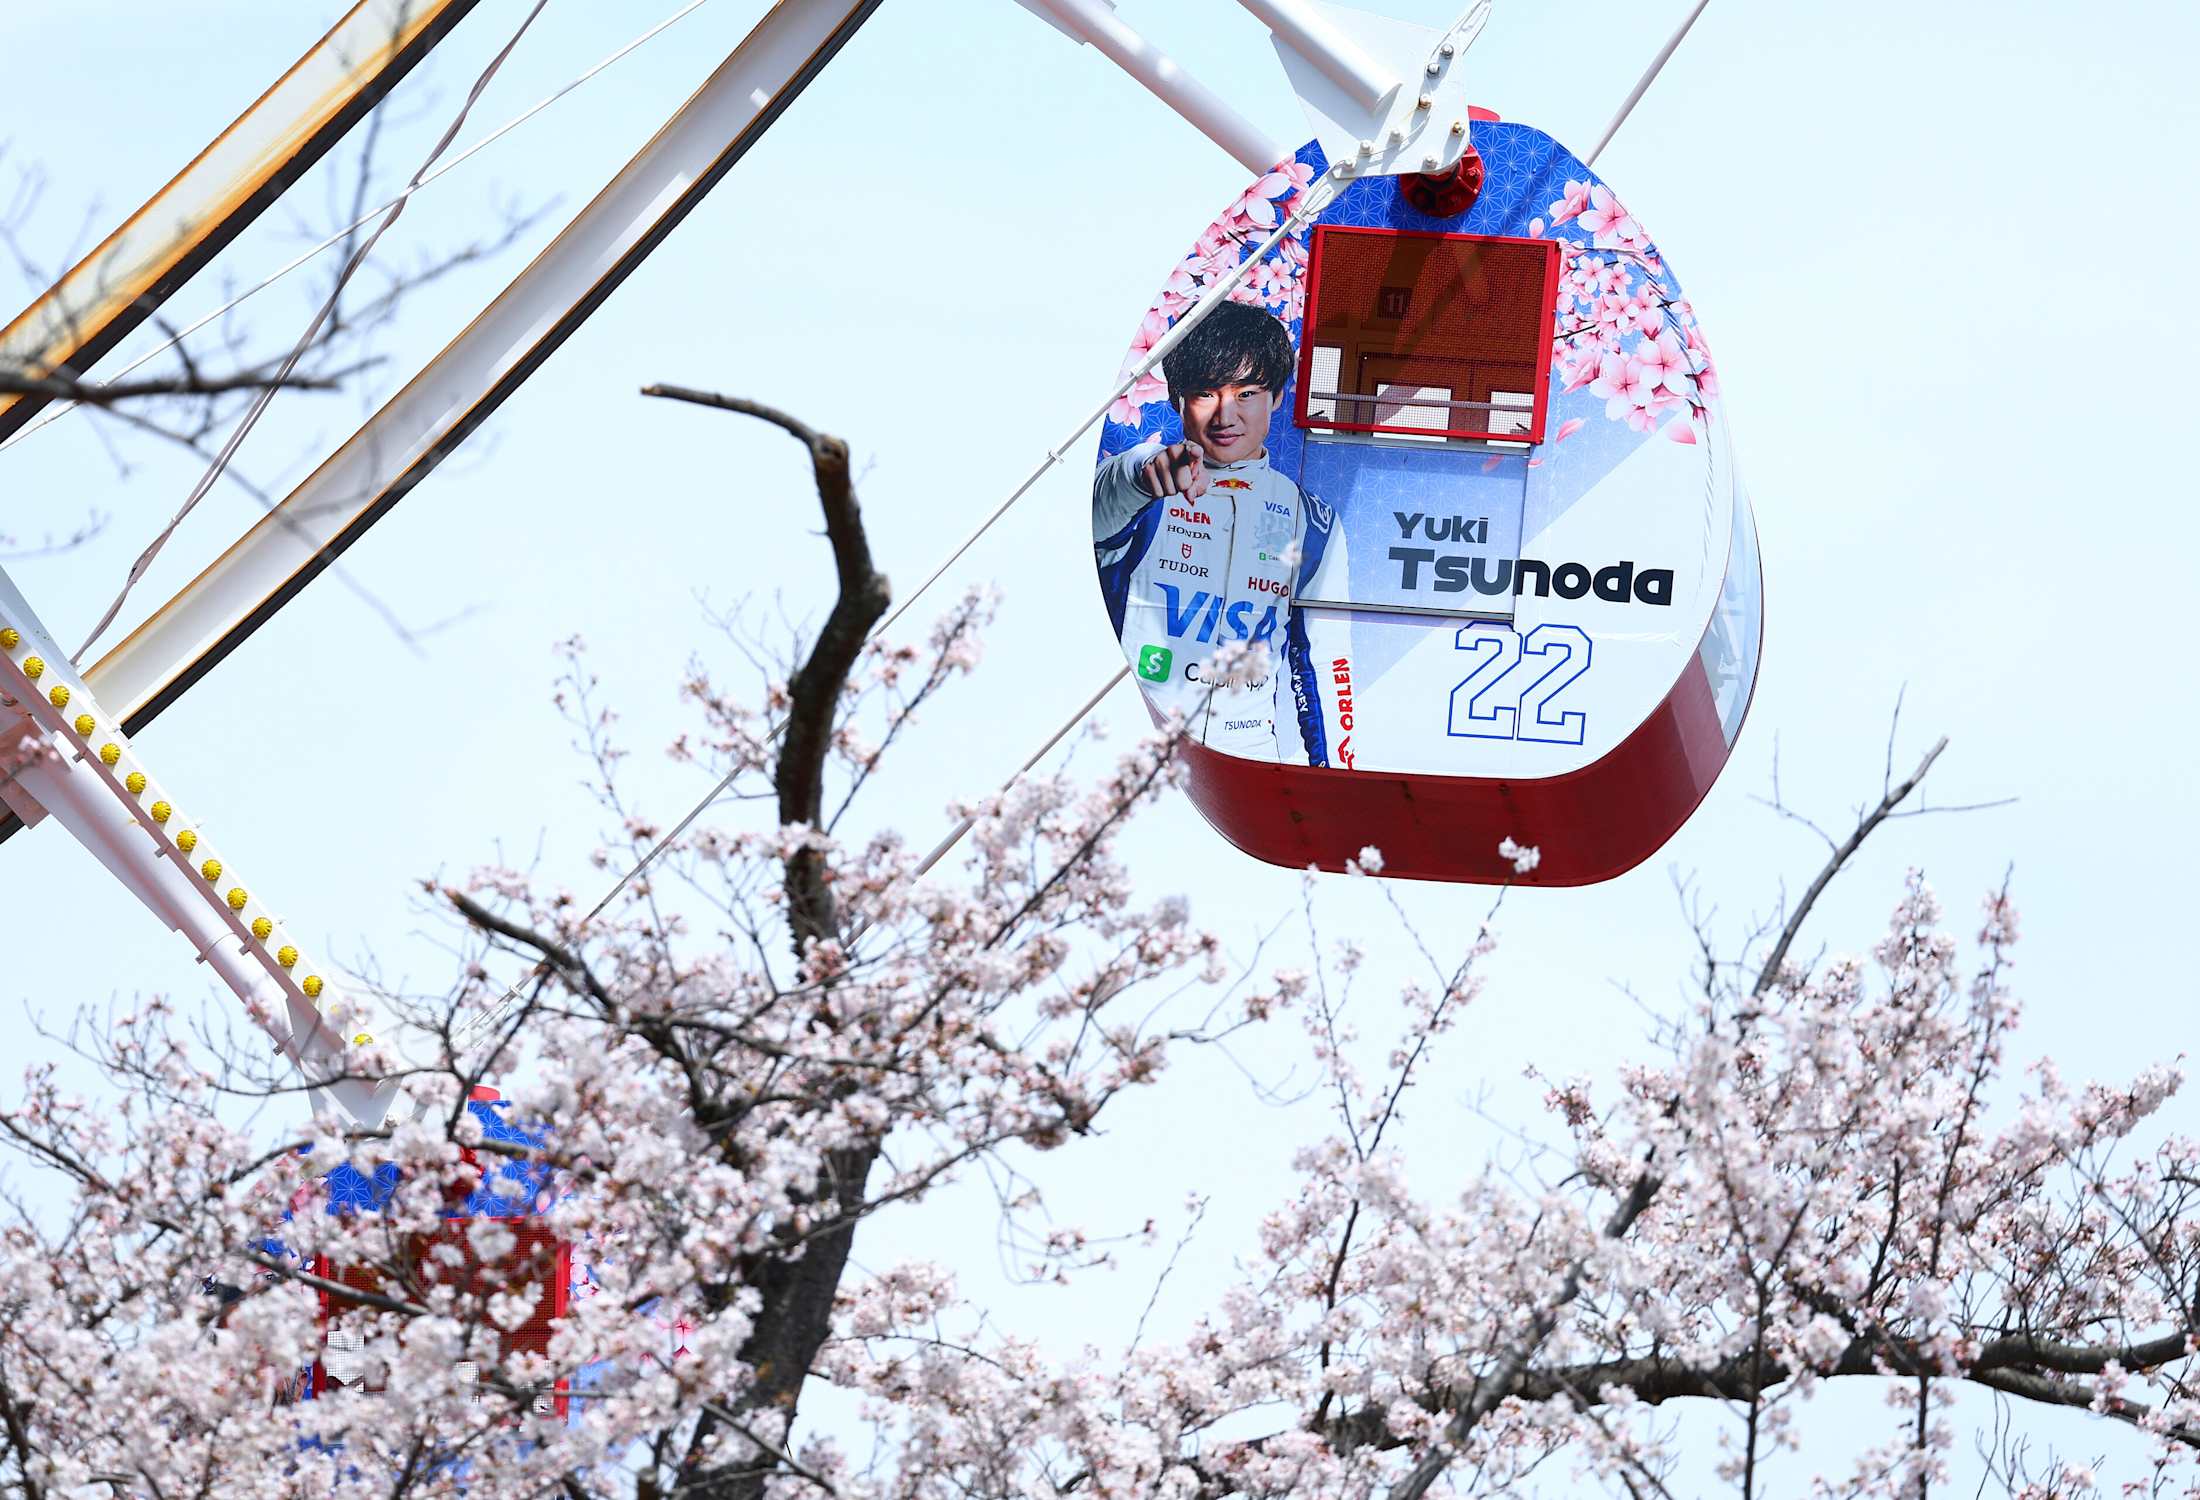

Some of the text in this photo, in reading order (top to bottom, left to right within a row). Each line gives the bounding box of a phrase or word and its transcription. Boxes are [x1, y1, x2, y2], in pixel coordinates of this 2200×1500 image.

[1169, 507, 1211, 525] ORLEN
[1264, 501, 1291, 518] VISA
[1167, 524, 1211, 541] HONDA
[1393, 511, 1488, 544] Yuki
[1159, 558, 1209, 578] TUDOR
[1247, 576, 1289, 597] HUGO
[1153, 582, 1277, 650] VISA
[1447, 620, 1593, 745] 22
[1332, 657, 1354, 731] ORLEN
[1223, 719, 1262, 731] TSUNODA
